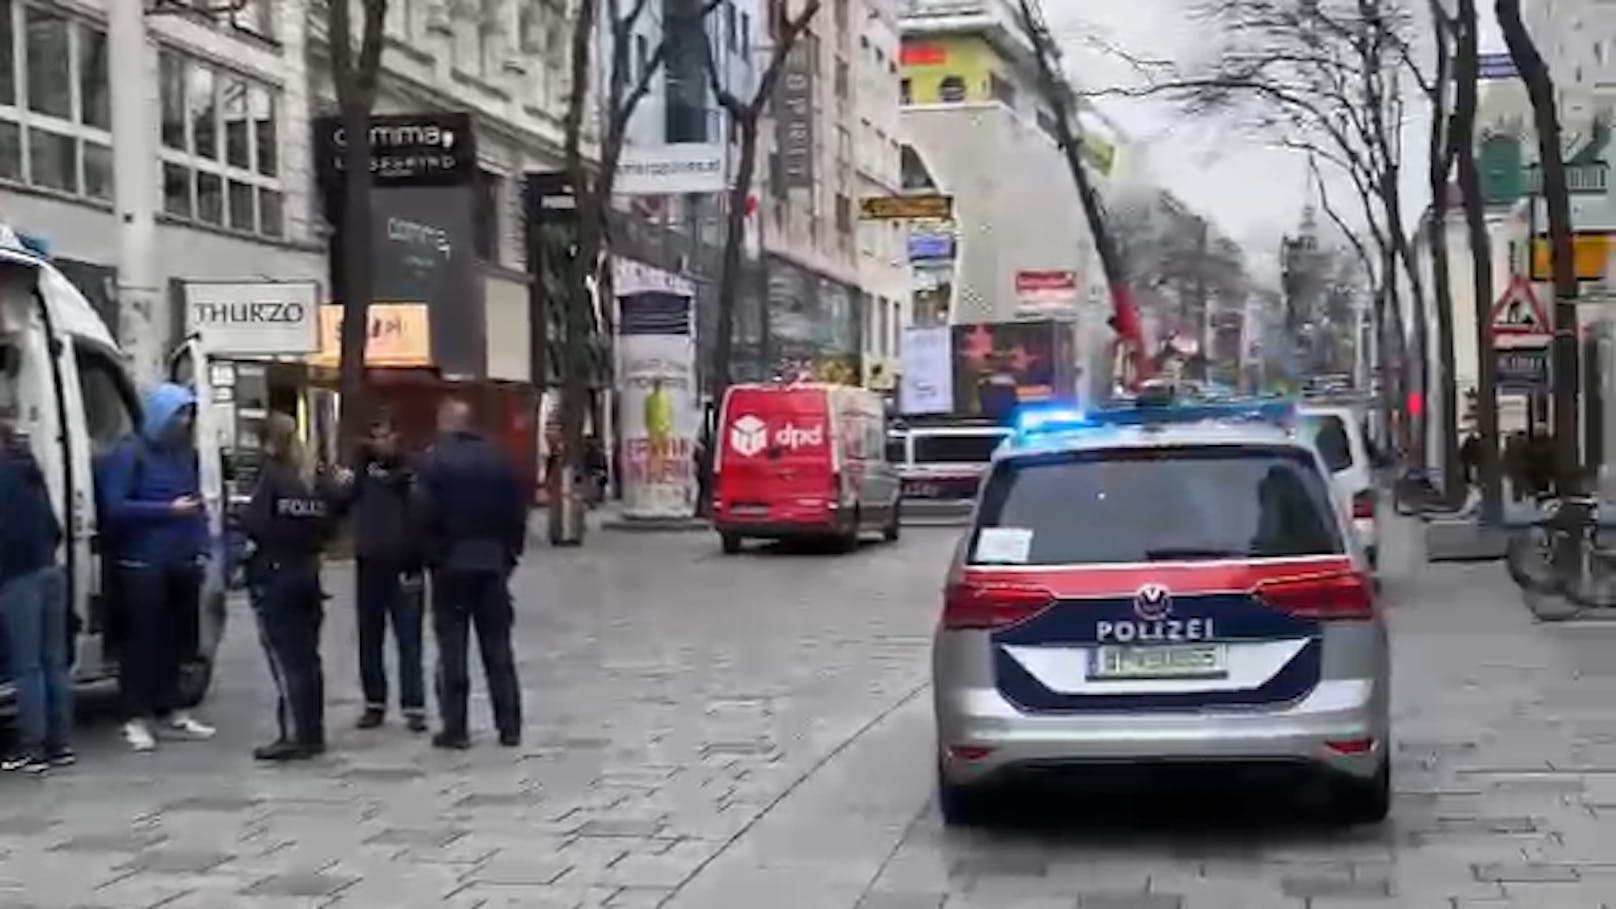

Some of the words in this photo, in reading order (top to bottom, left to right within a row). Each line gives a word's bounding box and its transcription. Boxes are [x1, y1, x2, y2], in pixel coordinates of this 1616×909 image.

[333, 126, 454, 148] cmma,
[193, 302, 304, 323] THURZO
[774, 422, 824, 447] dpd
[1096, 618, 1214, 642] POLIZEI
